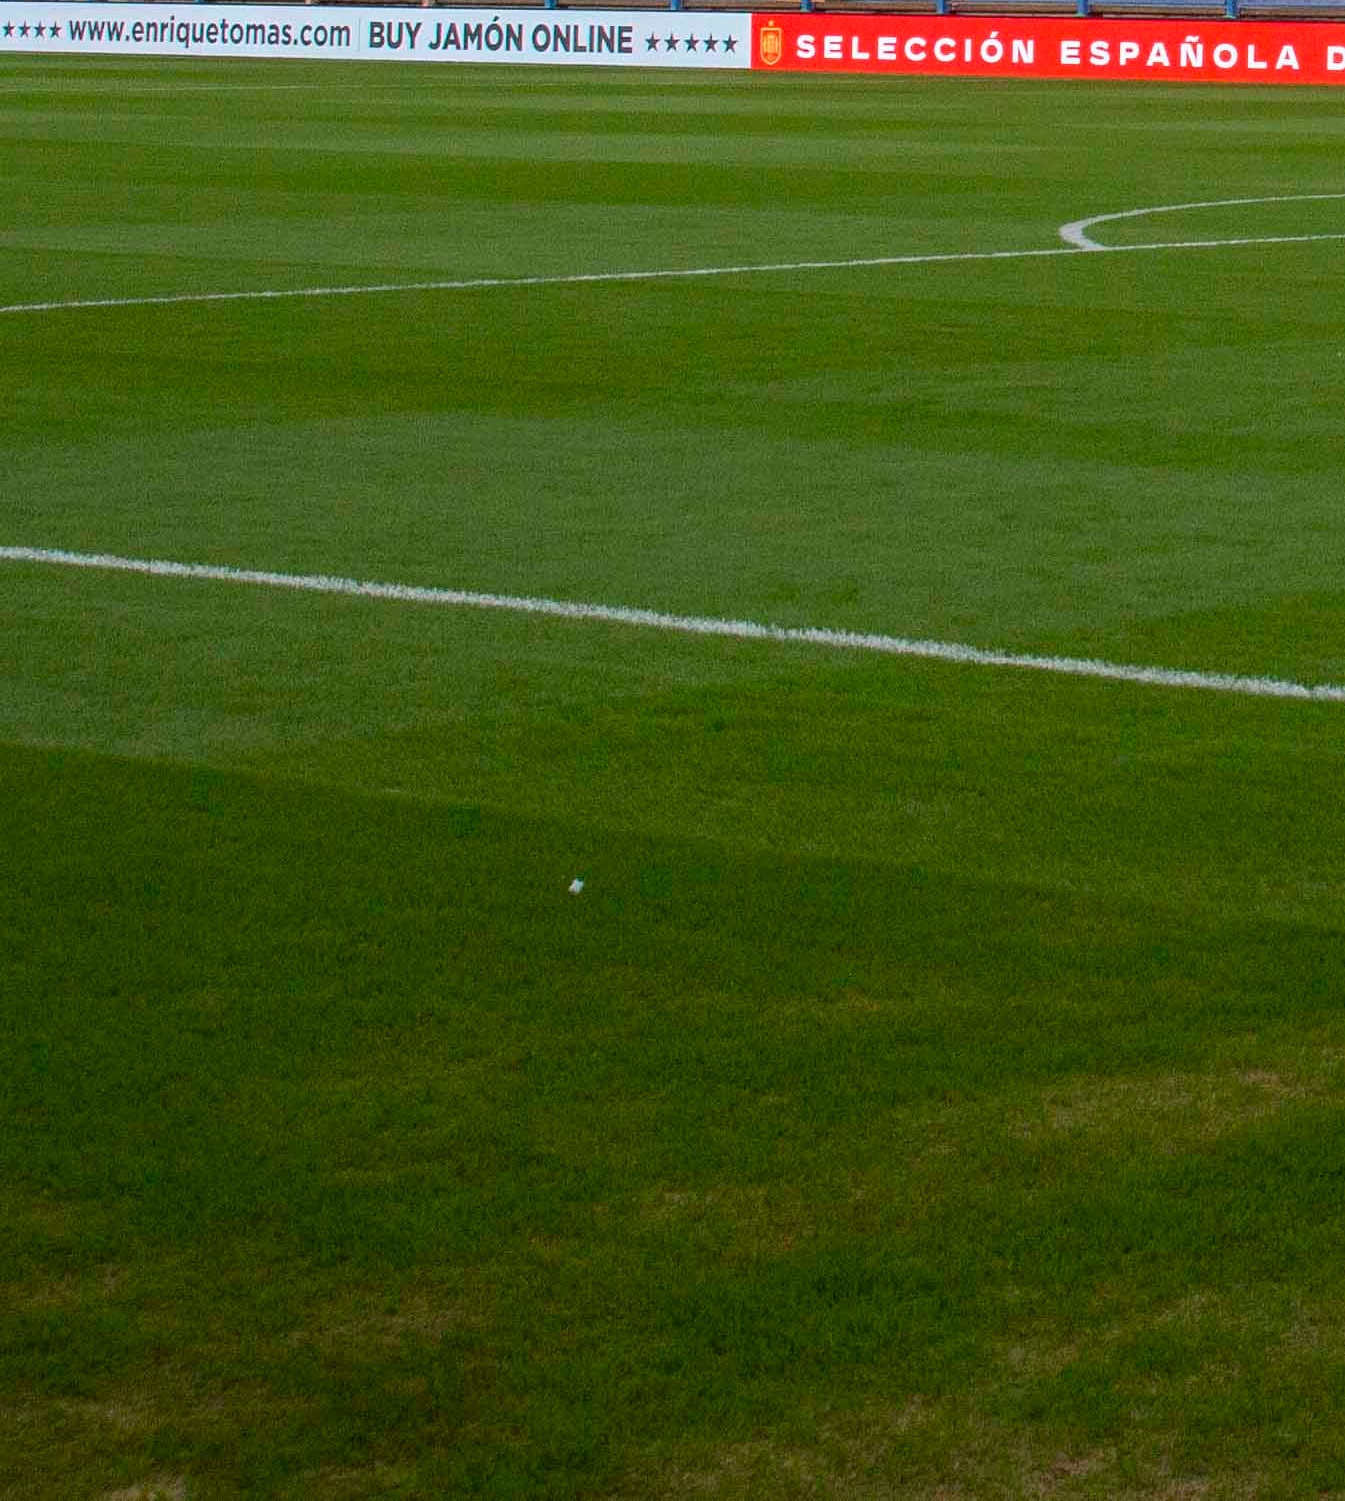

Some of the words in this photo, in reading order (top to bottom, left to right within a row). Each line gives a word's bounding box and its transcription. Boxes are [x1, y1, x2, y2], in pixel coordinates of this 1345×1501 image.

[68, 16, 351, 49] www.enriquetomas.com
[370, 23, 423, 51] BUY
[428, 15, 522, 53] JAMÓN
[532, 24, 634, 54] ONLINE
[796, 31, 1036, 65] SELECCIÓN
[1060, 35, 1300, 71] ESPAÑOLA
